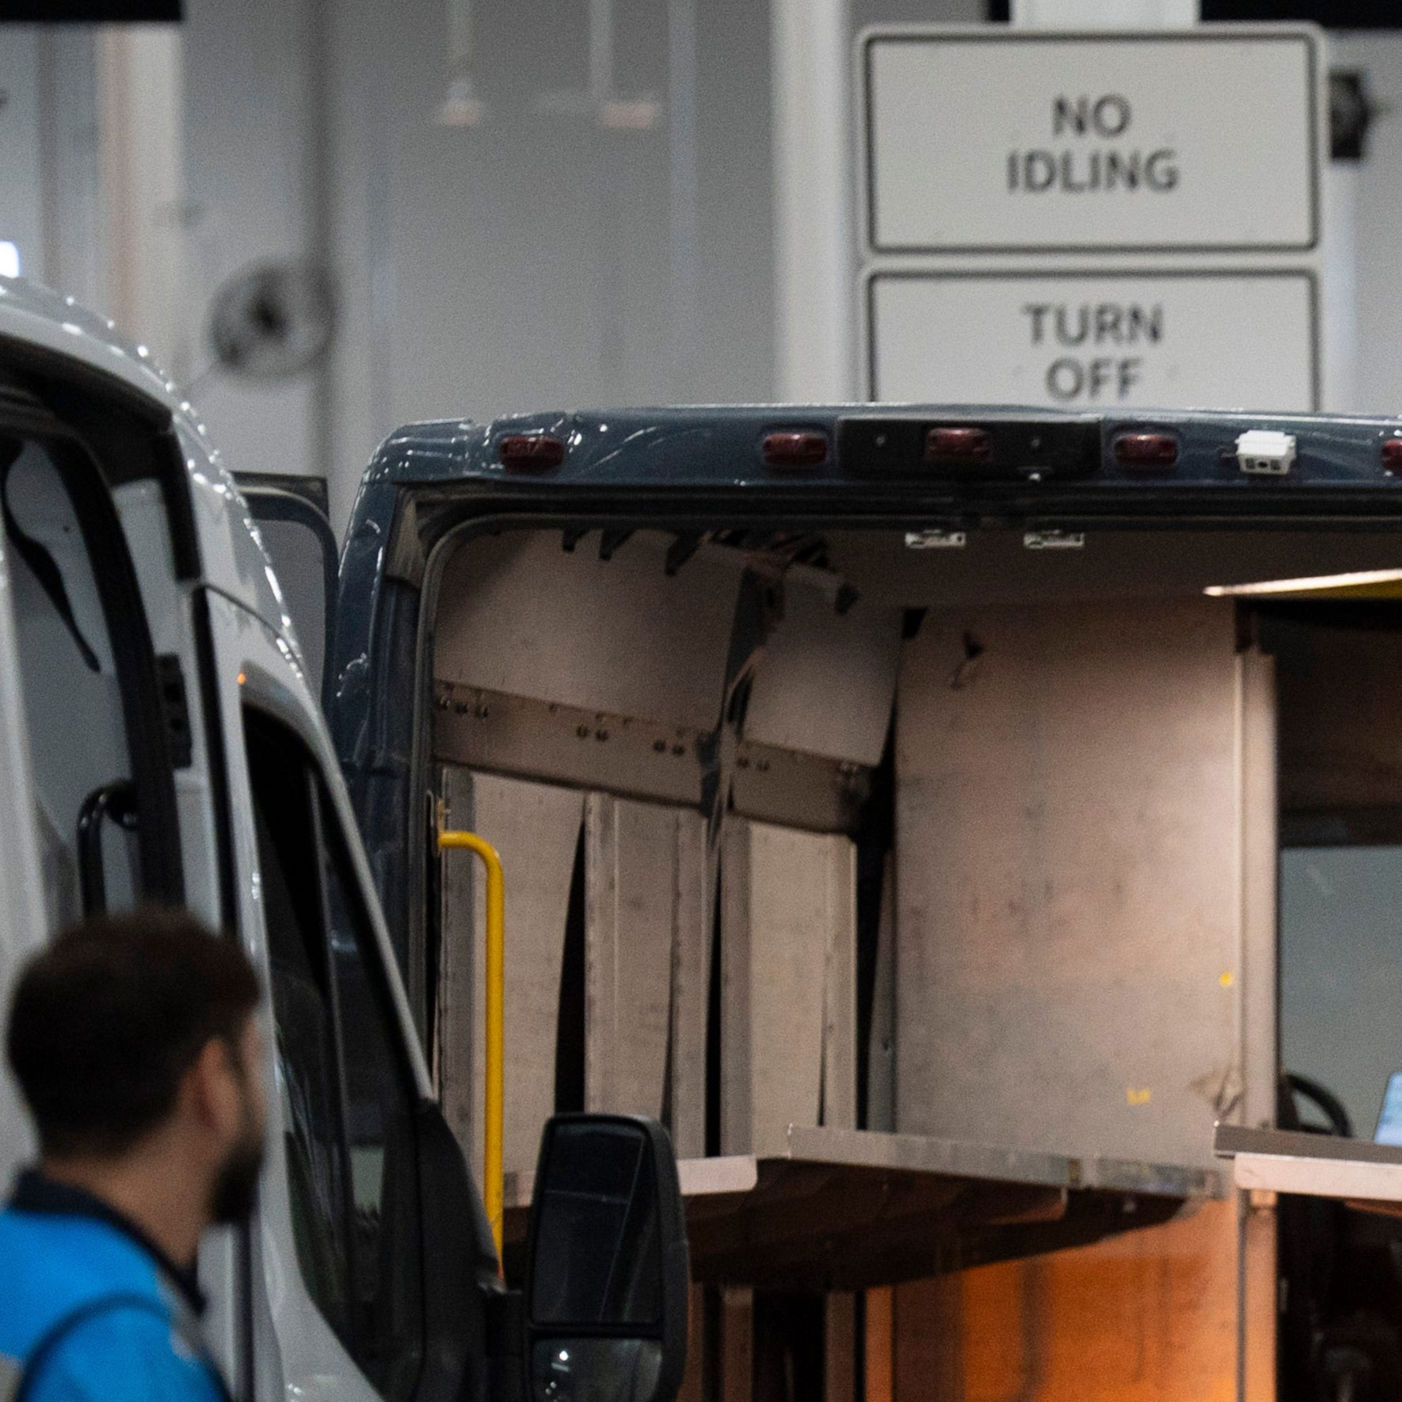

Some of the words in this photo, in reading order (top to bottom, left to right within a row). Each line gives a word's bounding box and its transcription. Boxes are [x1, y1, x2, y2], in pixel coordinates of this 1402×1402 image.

[1052, 95, 1132, 138] NO
[1007, 149, 1179, 194] IDLING
[1021, 303, 1164, 348] TURN
[1045, 357, 1145, 401] OFF
